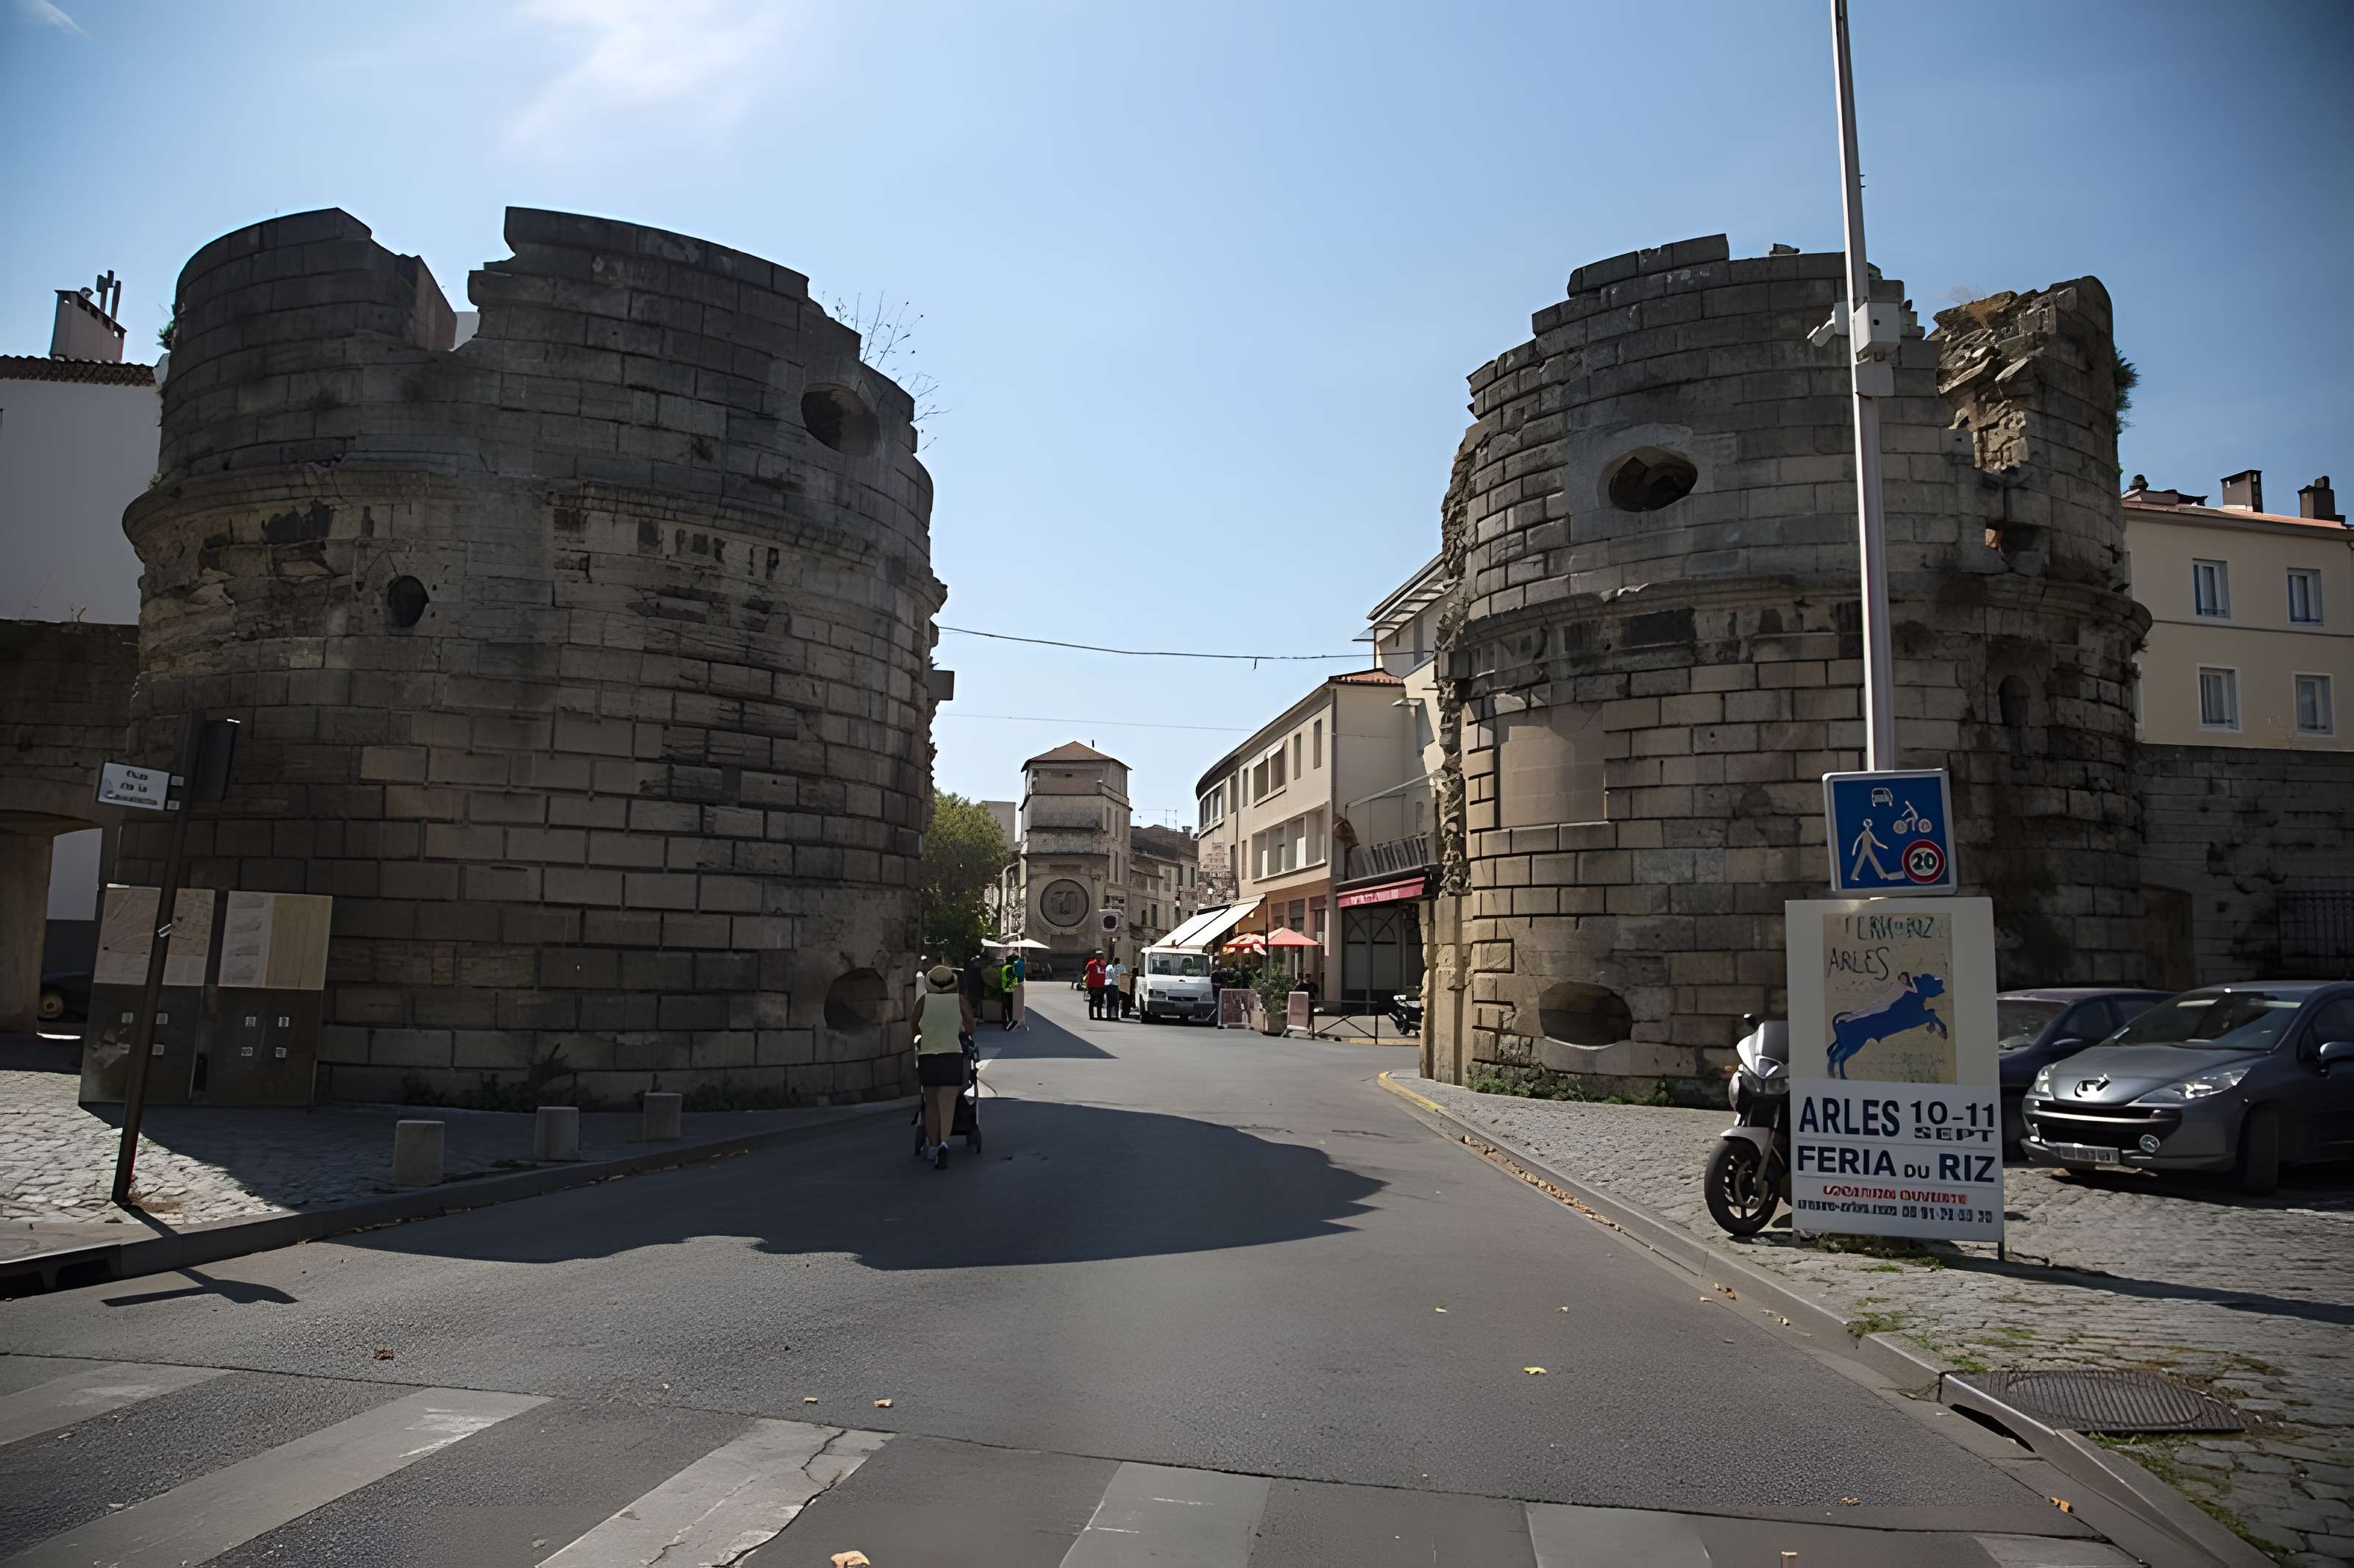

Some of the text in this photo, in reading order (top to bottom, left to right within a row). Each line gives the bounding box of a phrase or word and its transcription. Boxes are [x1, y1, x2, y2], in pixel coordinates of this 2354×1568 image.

[1911, 852, 1938, 871] 20
[1827, 947, 1890, 981] ARLES
[1799, 1096, 1900, 1137] ARLES
[1914, 1126, 1995, 1142] SEPT
[1797, 1145, 1995, 1183] FERIA DU RIZ
